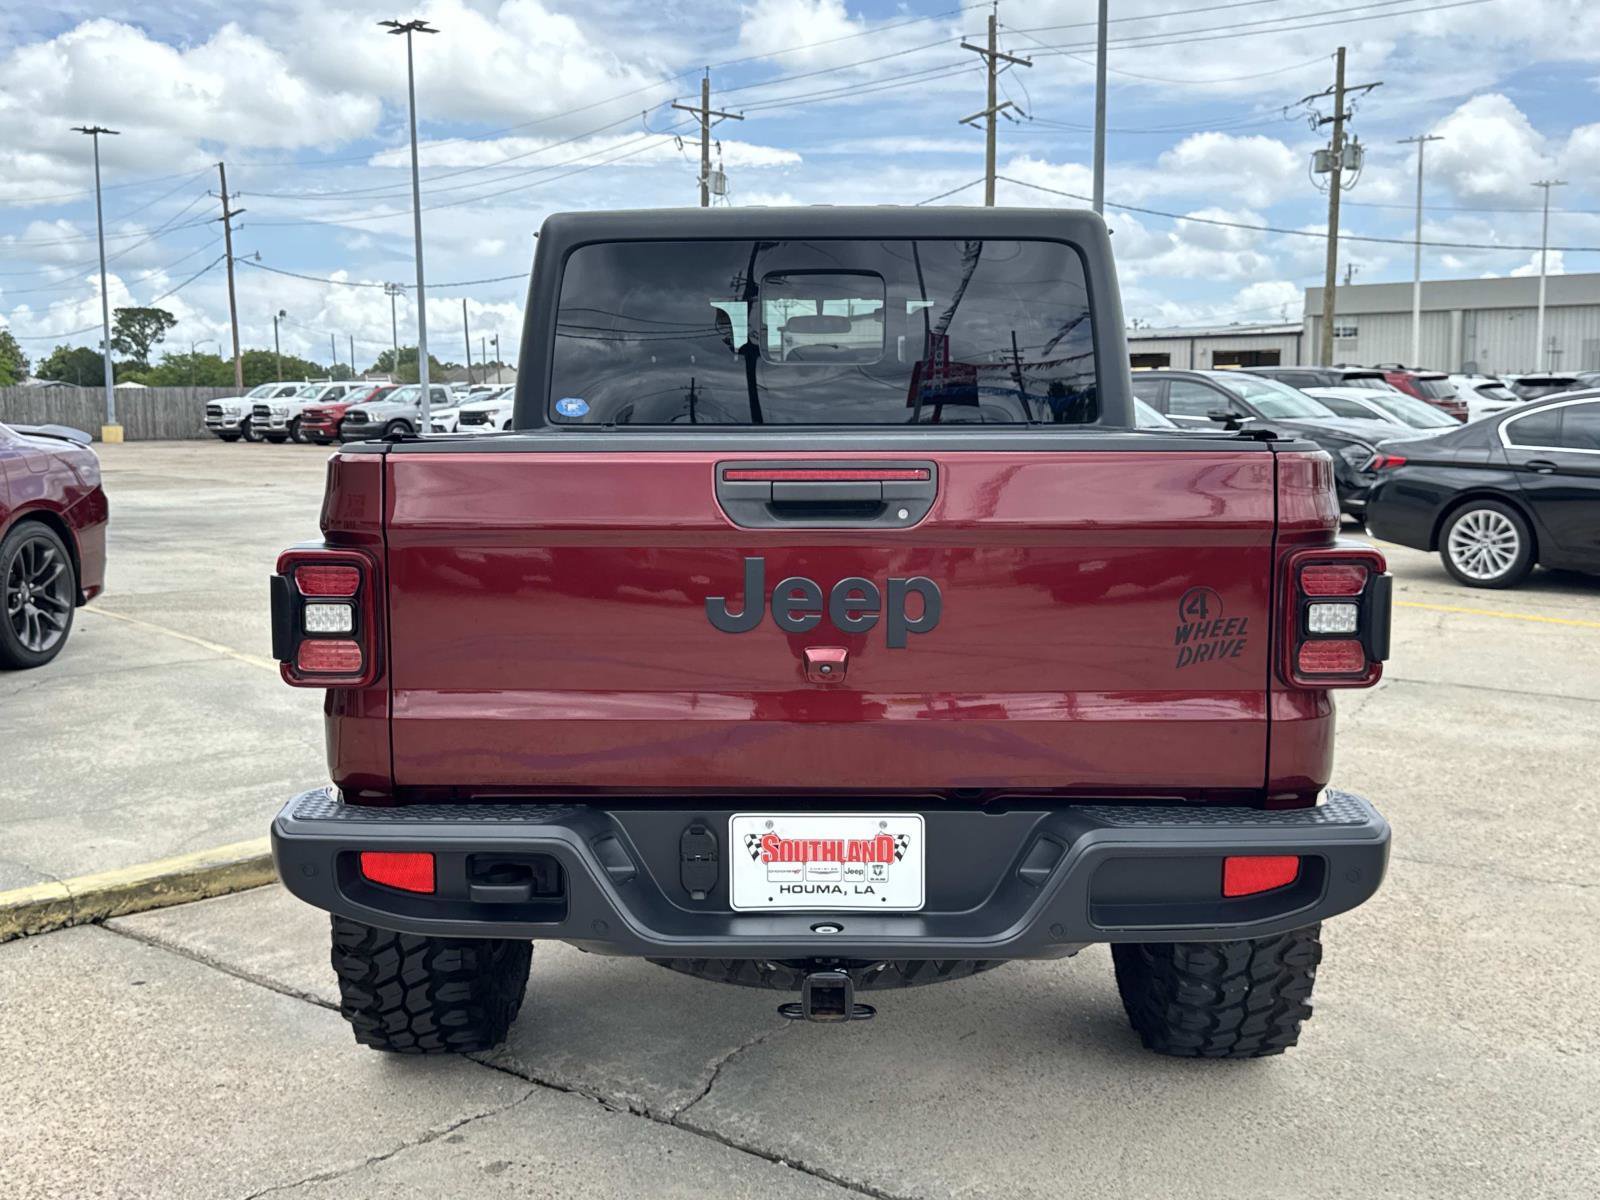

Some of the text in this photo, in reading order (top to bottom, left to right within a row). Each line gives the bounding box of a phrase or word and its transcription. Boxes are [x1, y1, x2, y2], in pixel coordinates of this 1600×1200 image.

[706, 557, 942, 649] Jeep
[1186, 593, 1208, 619] 4
[1175, 617, 1248, 645] WHEEL
[1176, 639, 1247, 668] DRIVE
[761, 834, 895, 864] SOUTHLAND
[844, 867, 864, 875] Jeep
[780, 885, 875, 896] HOUMA, LA
